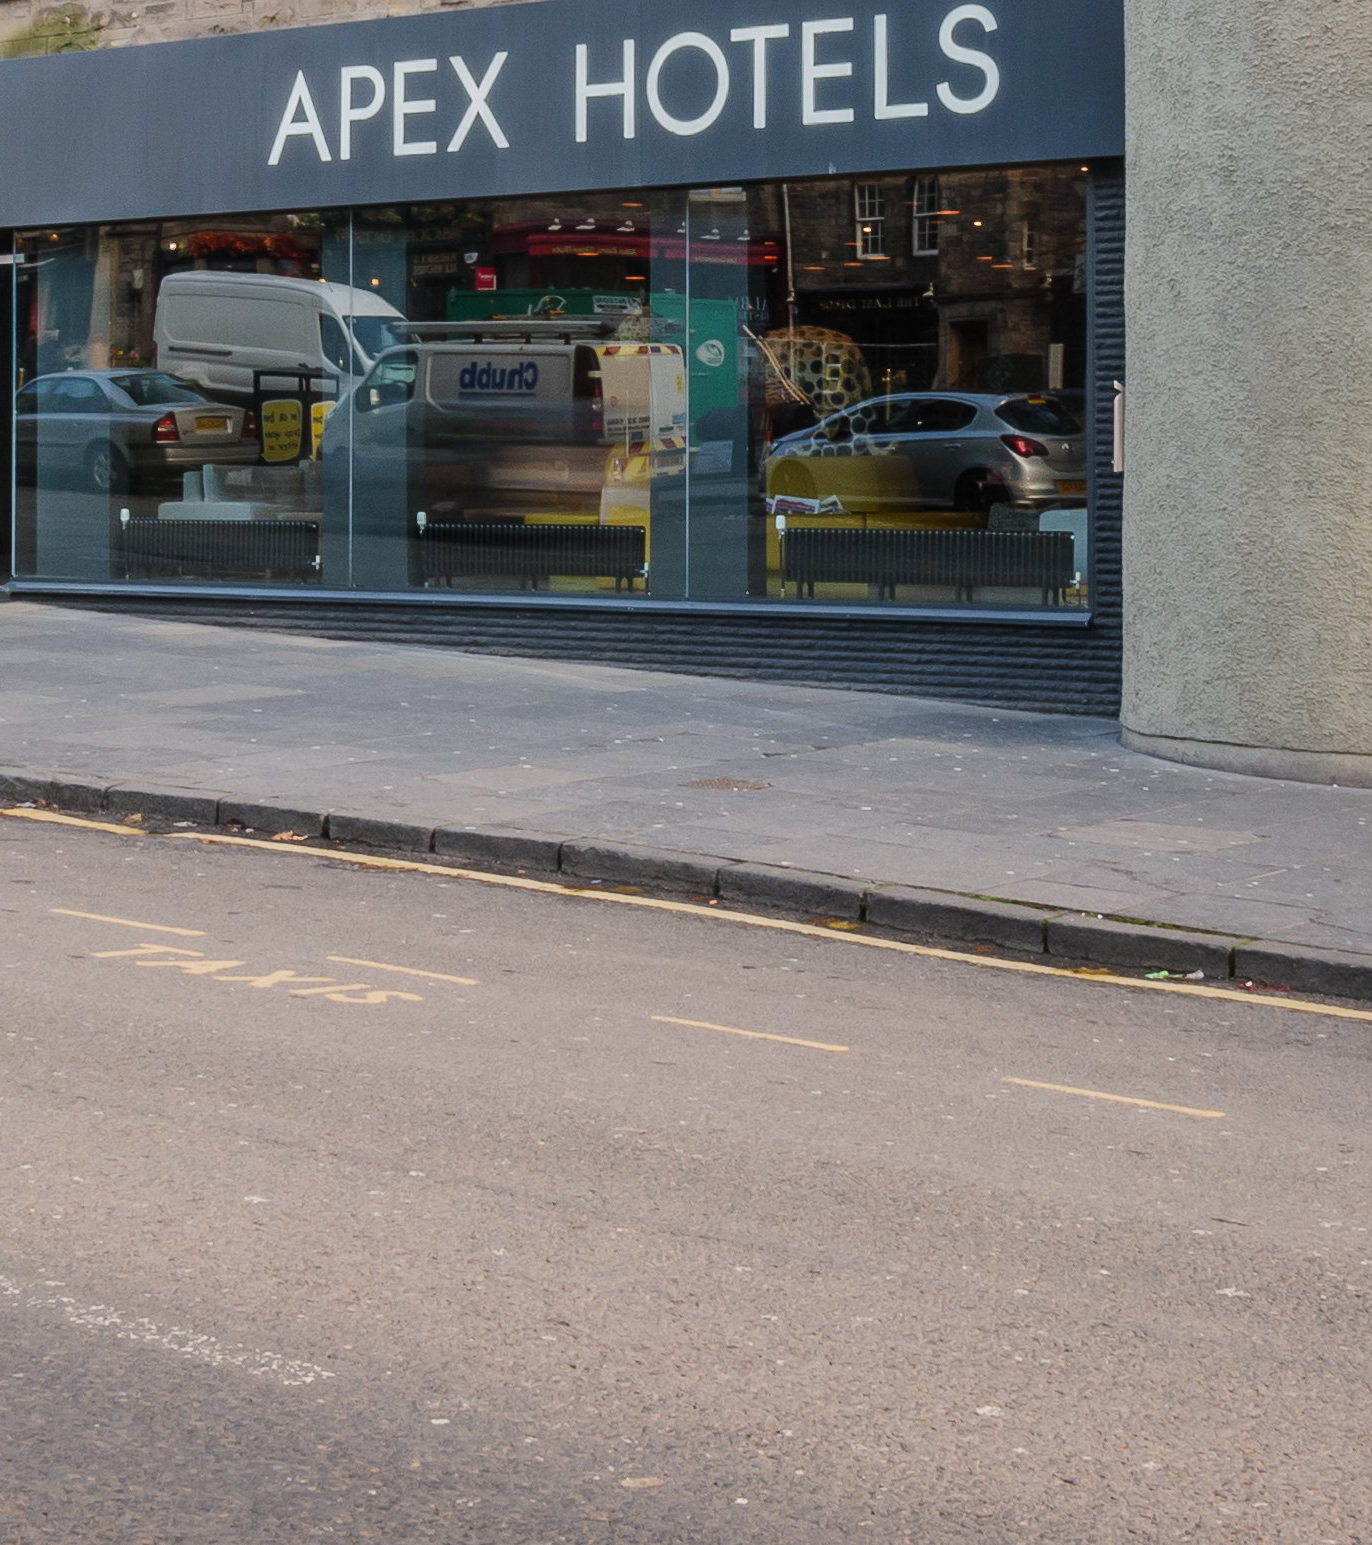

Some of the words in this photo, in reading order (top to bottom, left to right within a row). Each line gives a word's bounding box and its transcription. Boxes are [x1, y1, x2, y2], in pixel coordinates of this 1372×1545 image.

[267, 50, 510, 167] APEX
[575, 4, 1001, 144] HOTELS
[90, 942, 424, 1005] TAXIS
